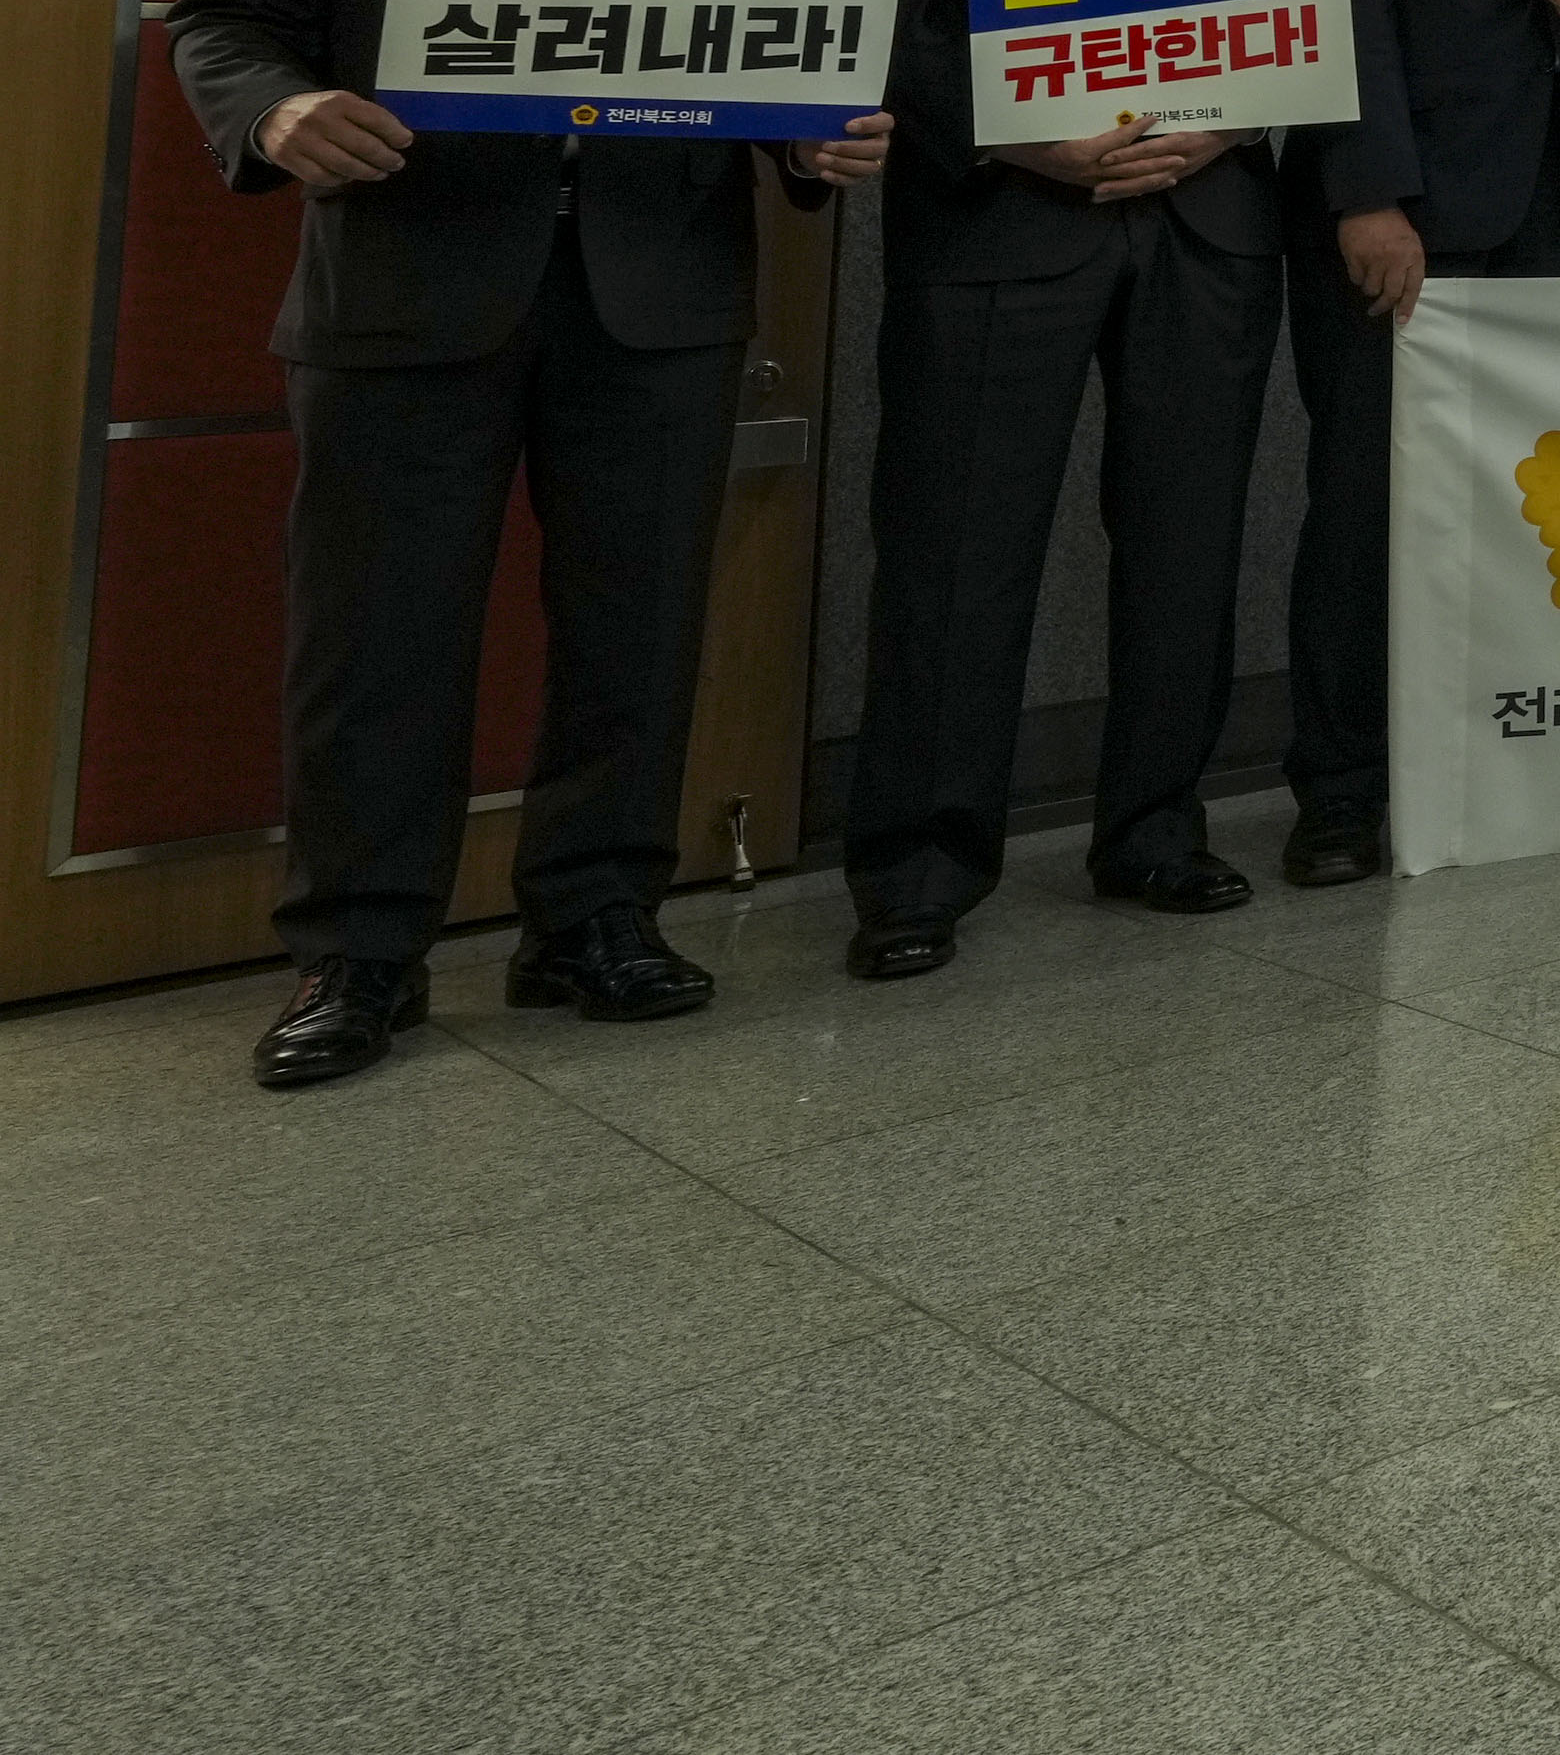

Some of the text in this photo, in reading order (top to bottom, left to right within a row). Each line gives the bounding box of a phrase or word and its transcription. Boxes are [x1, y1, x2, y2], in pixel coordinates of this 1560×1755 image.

[423, 3, 865, 76] 살려내라!
[1004, 4, 1319, 102] 규탄한다!
[606, 106, 713, 126] 전라북도의회
